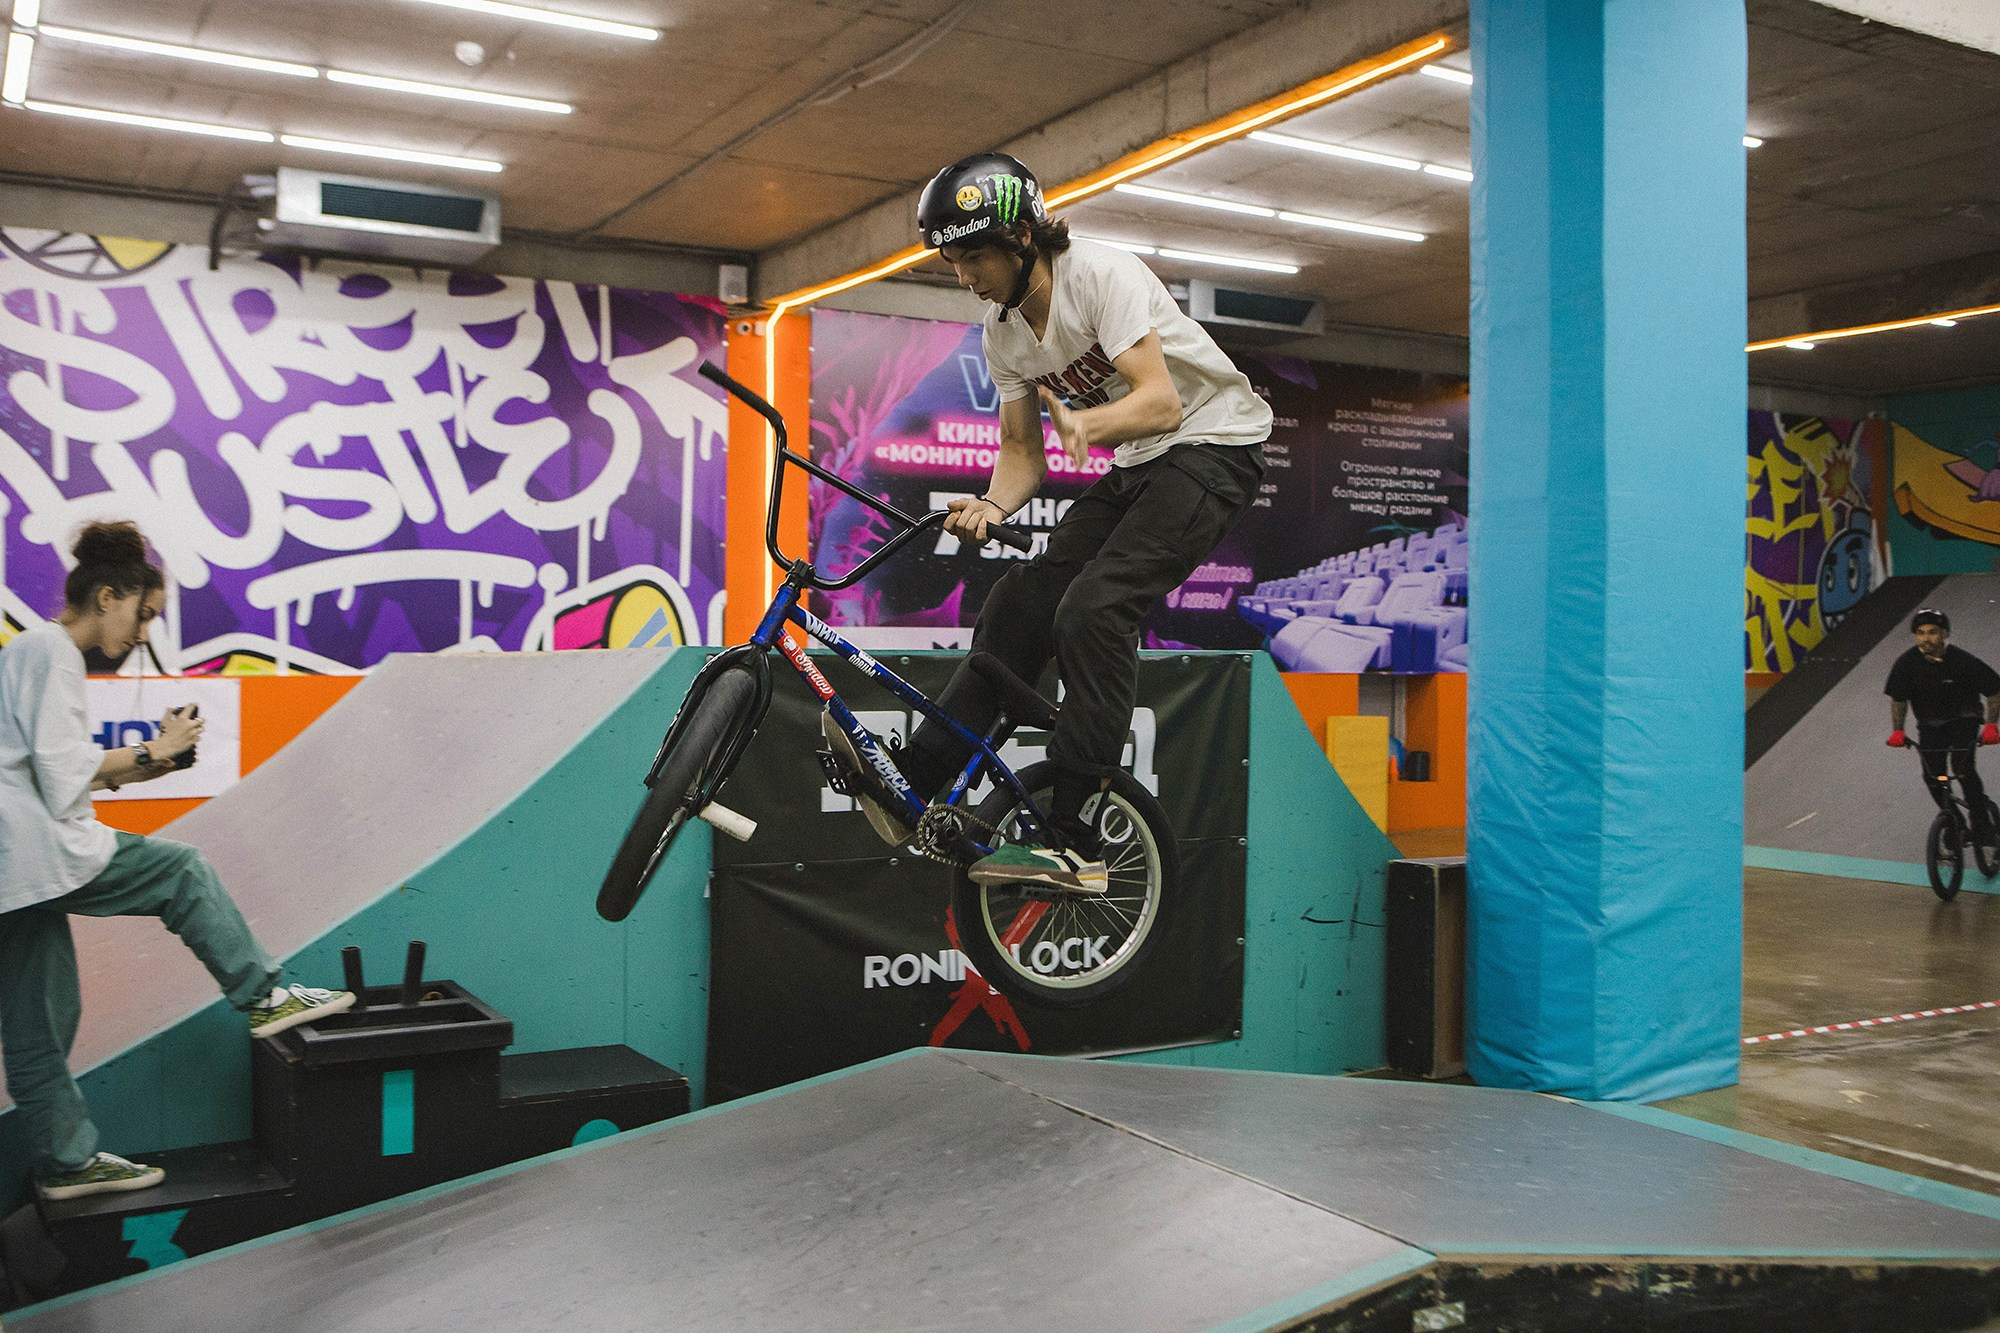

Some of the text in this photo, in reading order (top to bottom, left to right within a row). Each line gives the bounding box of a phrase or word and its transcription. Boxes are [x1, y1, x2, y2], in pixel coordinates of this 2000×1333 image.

[943, 216, 990, 243] Shadow
[875, 443, 1000, 468] «МОНИТО
[1340, 460, 1442, 478] Огромное личное
[1347, 476, 1436, 490] пространство и
[1332, 485, 1449, 504] большое расстояние
[1350, 503, 1433, 516] между рядами
